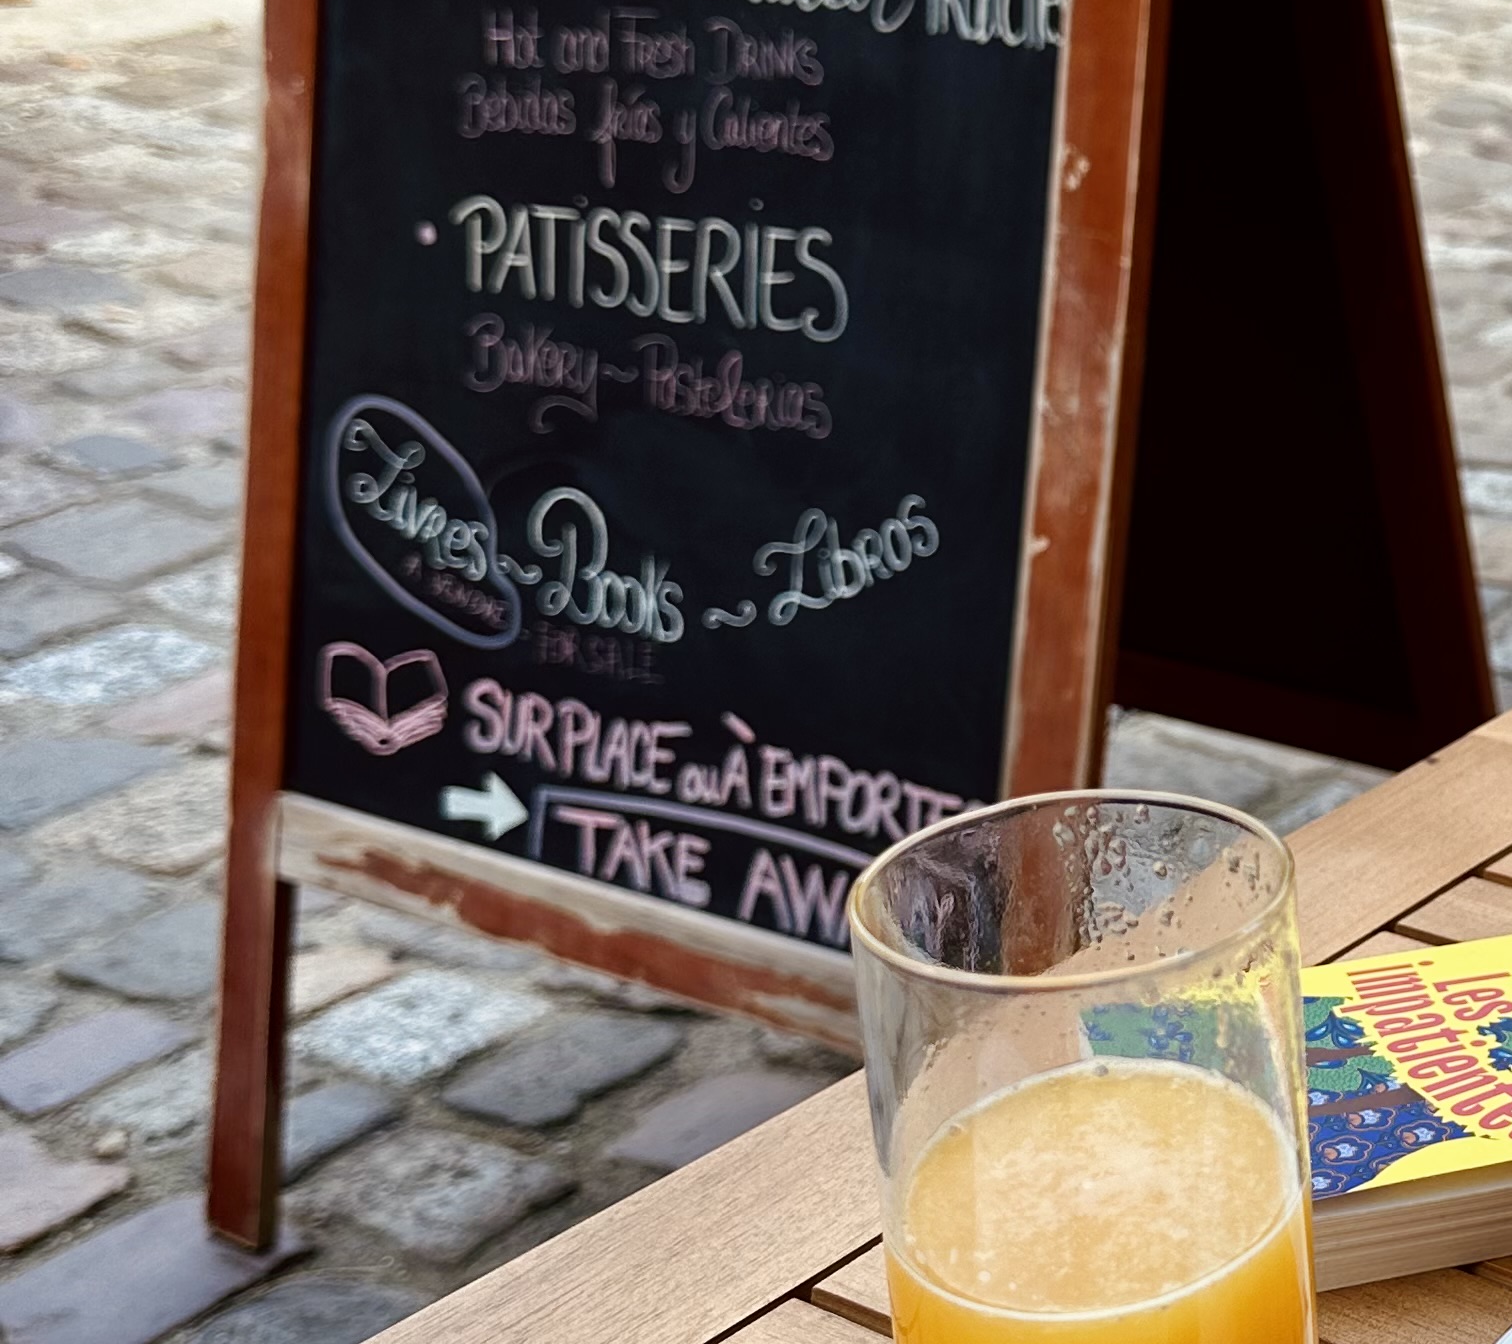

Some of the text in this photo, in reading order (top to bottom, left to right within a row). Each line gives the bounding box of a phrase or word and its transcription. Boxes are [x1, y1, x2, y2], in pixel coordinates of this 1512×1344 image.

[482, 5, 544, 69] Hot
[662, 109, 697, 194] y
[447, 194, 849, 343] PATISSERIES
[527, 487, 684, 643] Books
[759, 744, 987, 843] EMPORT
[553, 806, 850, 947] TAKE AW
